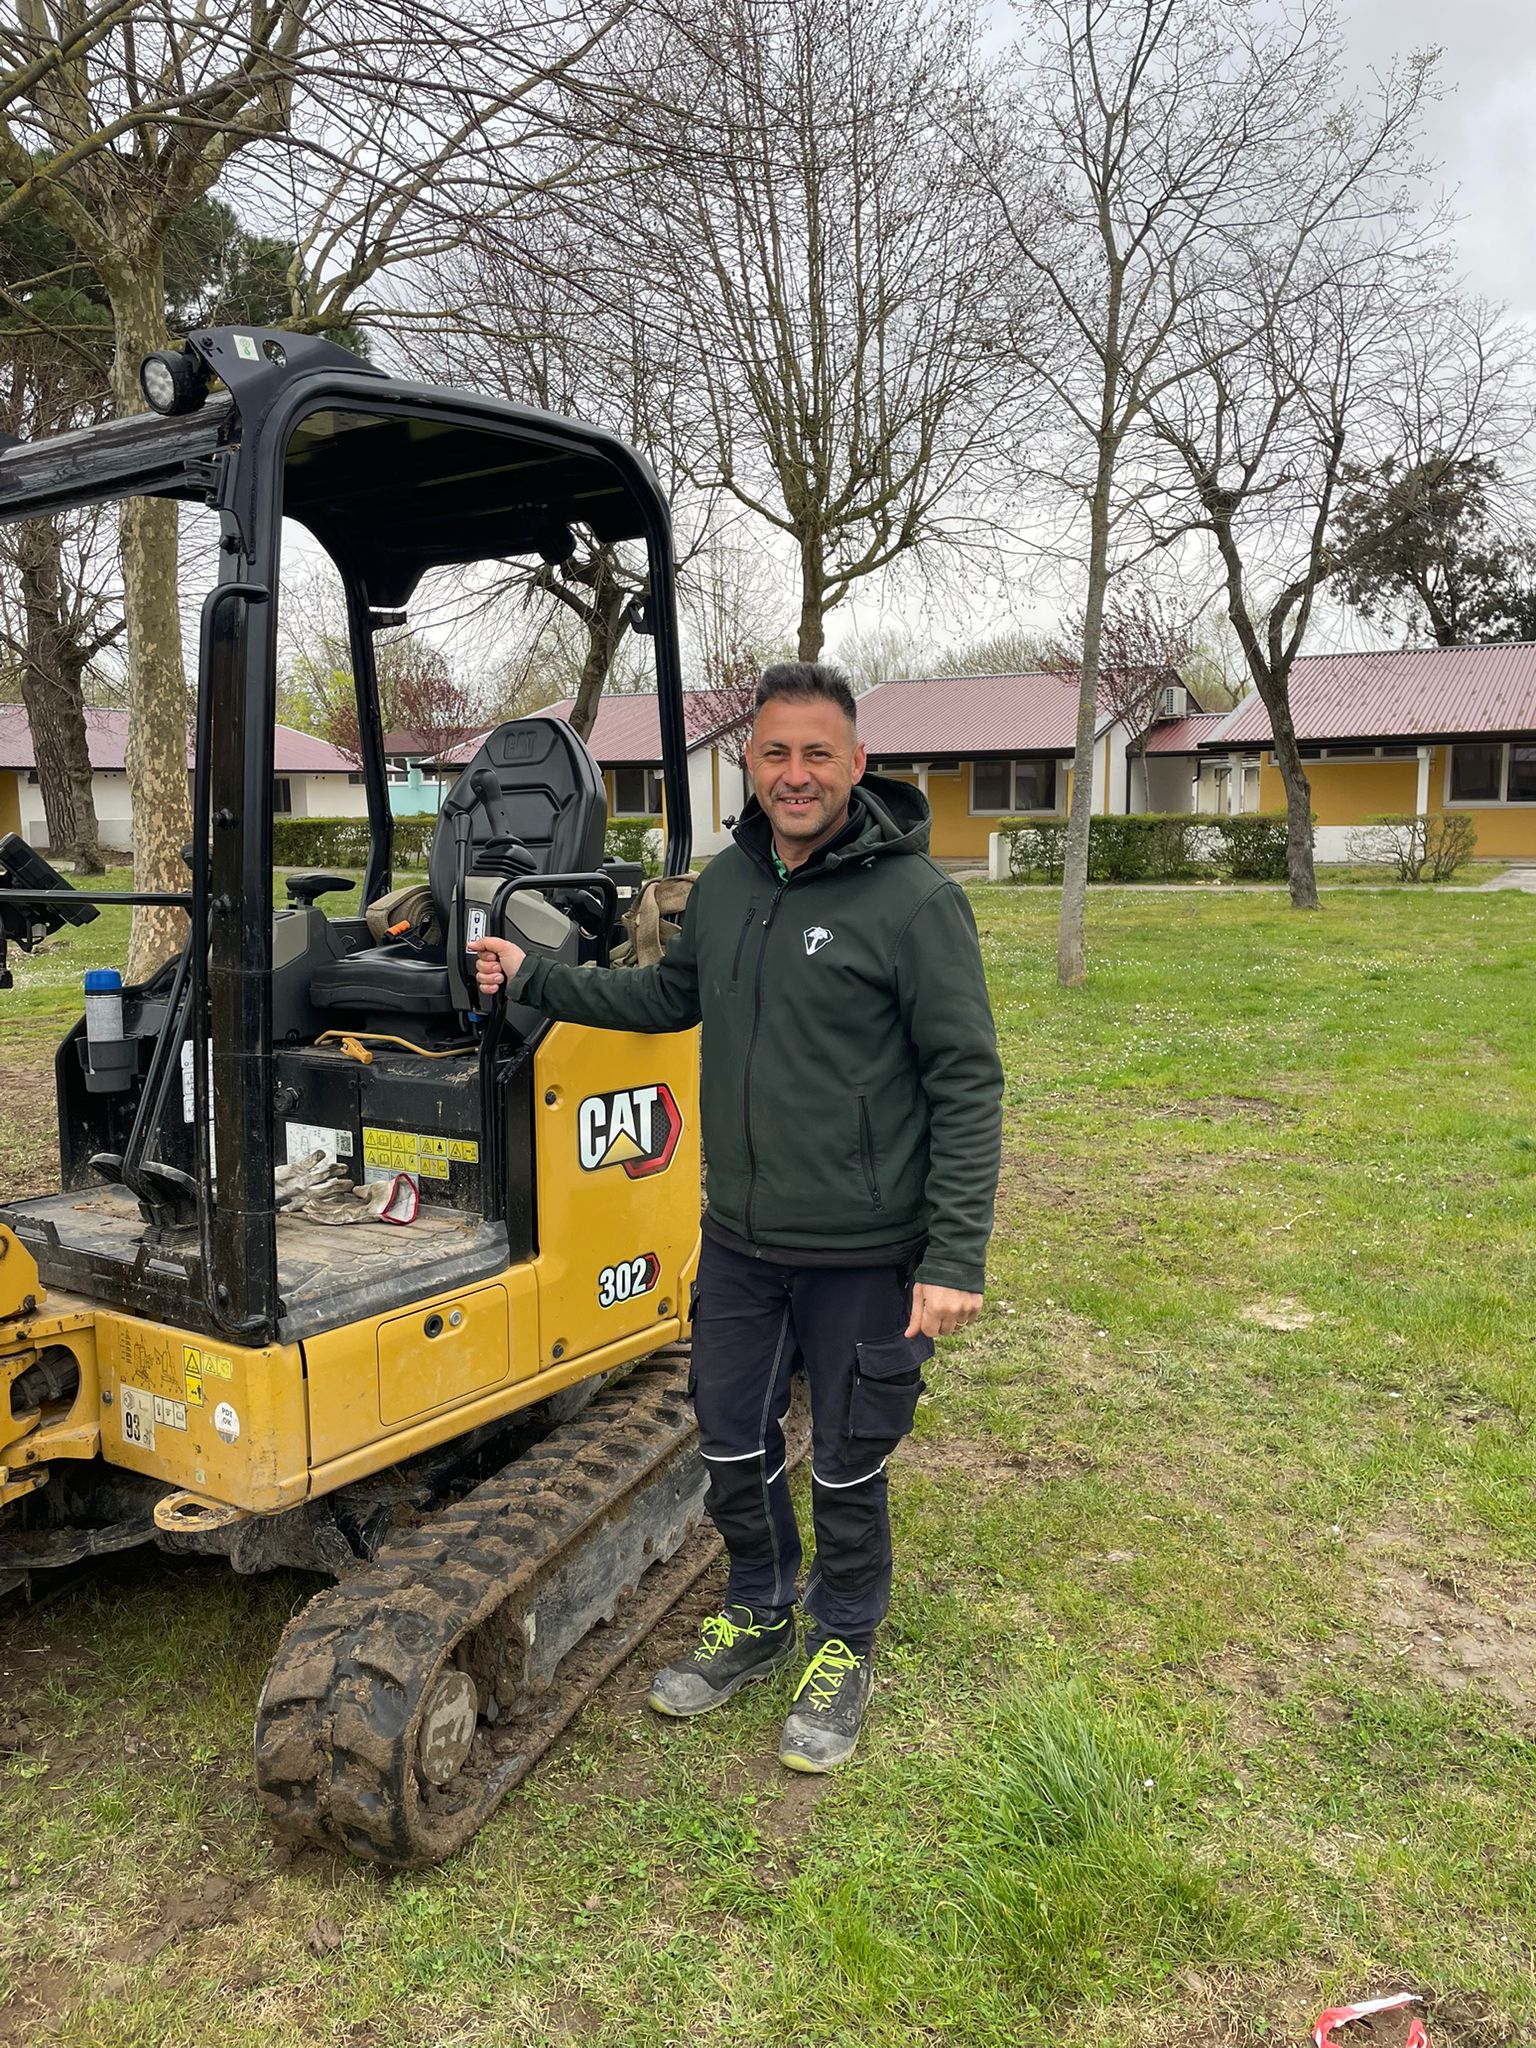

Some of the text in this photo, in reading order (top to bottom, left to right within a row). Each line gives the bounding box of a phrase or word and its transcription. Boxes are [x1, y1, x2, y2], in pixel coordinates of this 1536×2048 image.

[579, 1086, 658, 1169] CAT
[600, 1256, 647, 1306] 302
[125, 1411, 141, 1442] 93
